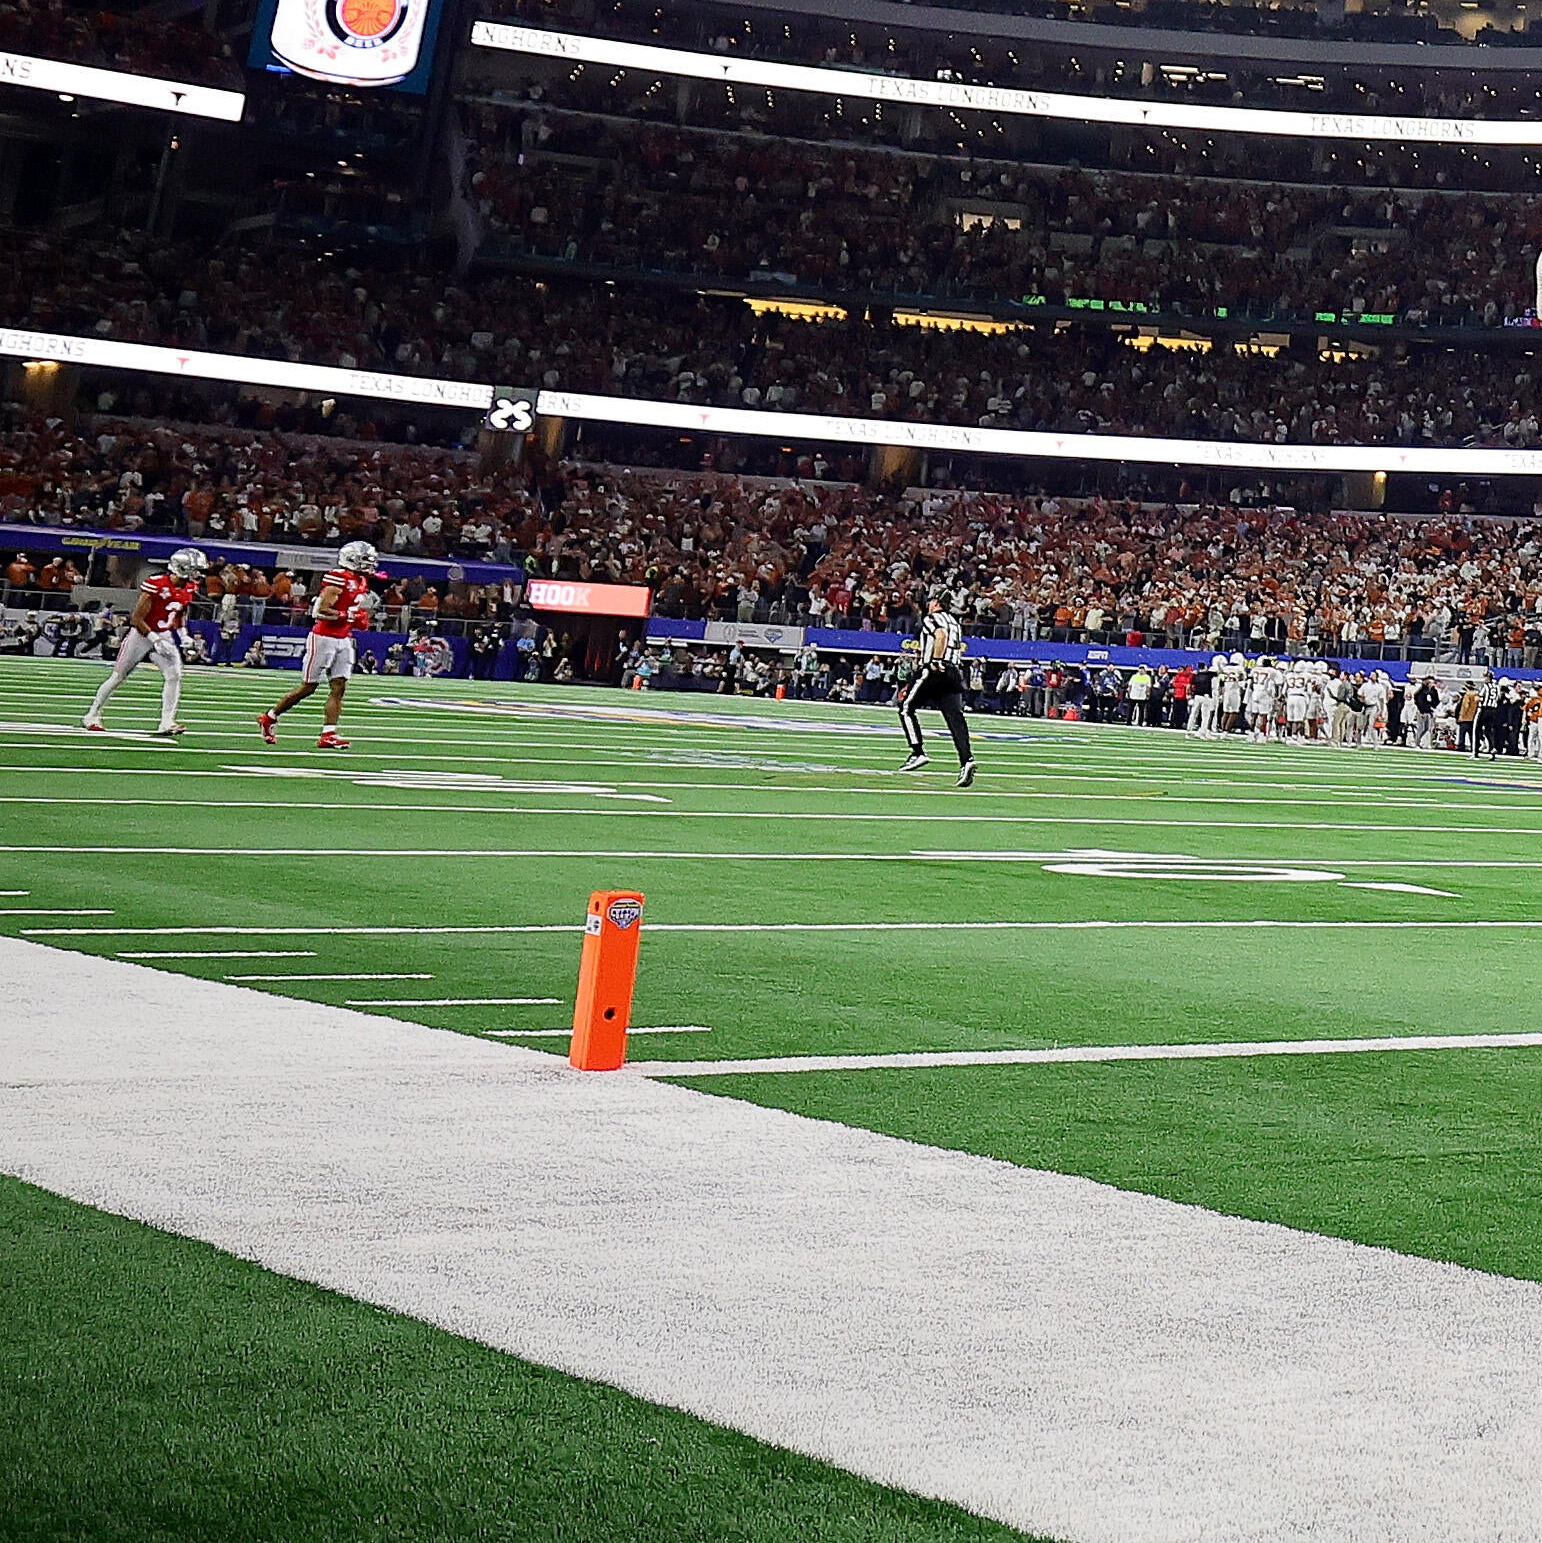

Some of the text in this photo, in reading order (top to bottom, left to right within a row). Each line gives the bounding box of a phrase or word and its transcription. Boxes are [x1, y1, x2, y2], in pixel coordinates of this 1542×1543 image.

[867, 78, 1050, 110] TEXAS LONGHORNS
[1309, 116, 1475, 138] TEXAS LONGHORNS
[350, 373, 404, 394] TEXAS
